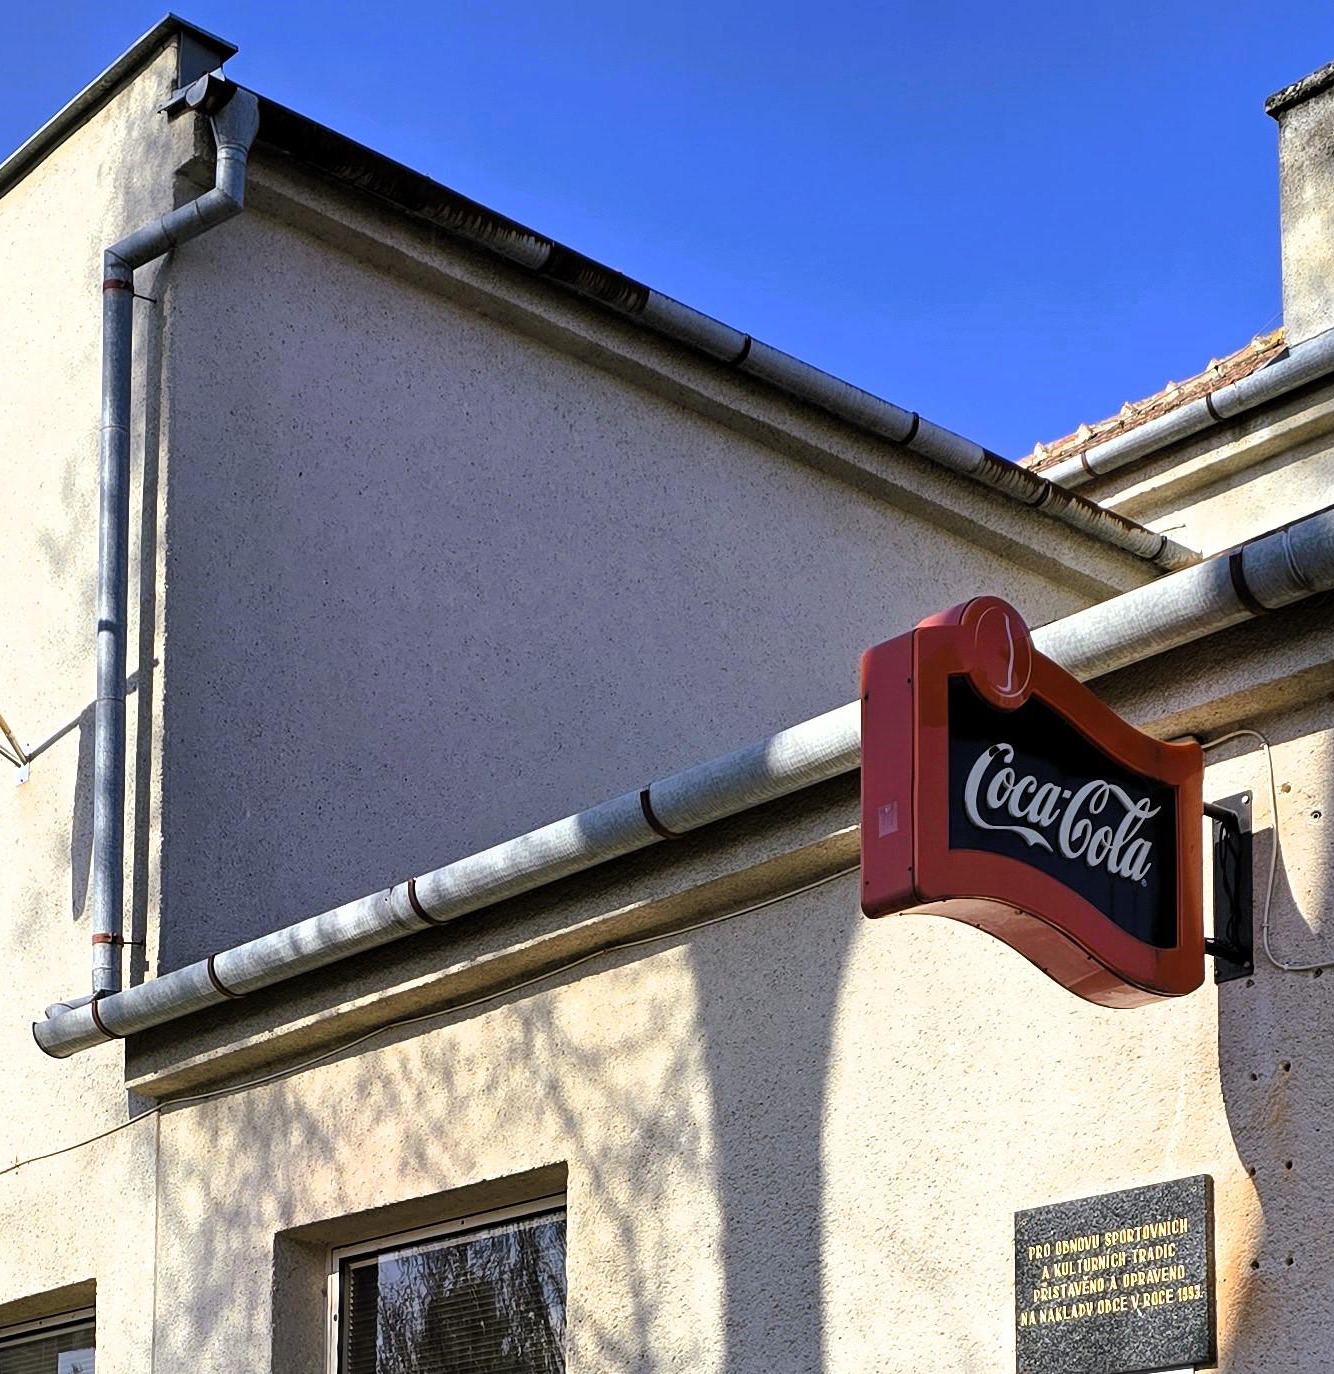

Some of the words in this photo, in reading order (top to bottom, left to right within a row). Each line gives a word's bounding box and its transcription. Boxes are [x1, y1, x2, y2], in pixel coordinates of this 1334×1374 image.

[965, 742, 1161, 883] Coca-Cola
[1028, 1242, 1051, 1260] PRO
[1055, 1234, 1100, 1256] OBNOVU
[1104, 1215, 1188, 1247] SPORTOVNÍCH
[1041, 1265, 1050, 1280] A
[1053, 1248, 1126, 1277] KULTURNÍCH
[1132, 1242, 1176, 1264] TRADIC
[1109, 1275, 1118, 1290] A
[1122, 1264, 1185, 1288] OPRAVENO
[1020, 1310, 1036, 1327] NA
[1097, 1296, 1128, 1314] OBCE
[1130, 1294, 1139, 1309] V
[1143, 1288, 1174, 1307] ROCE
